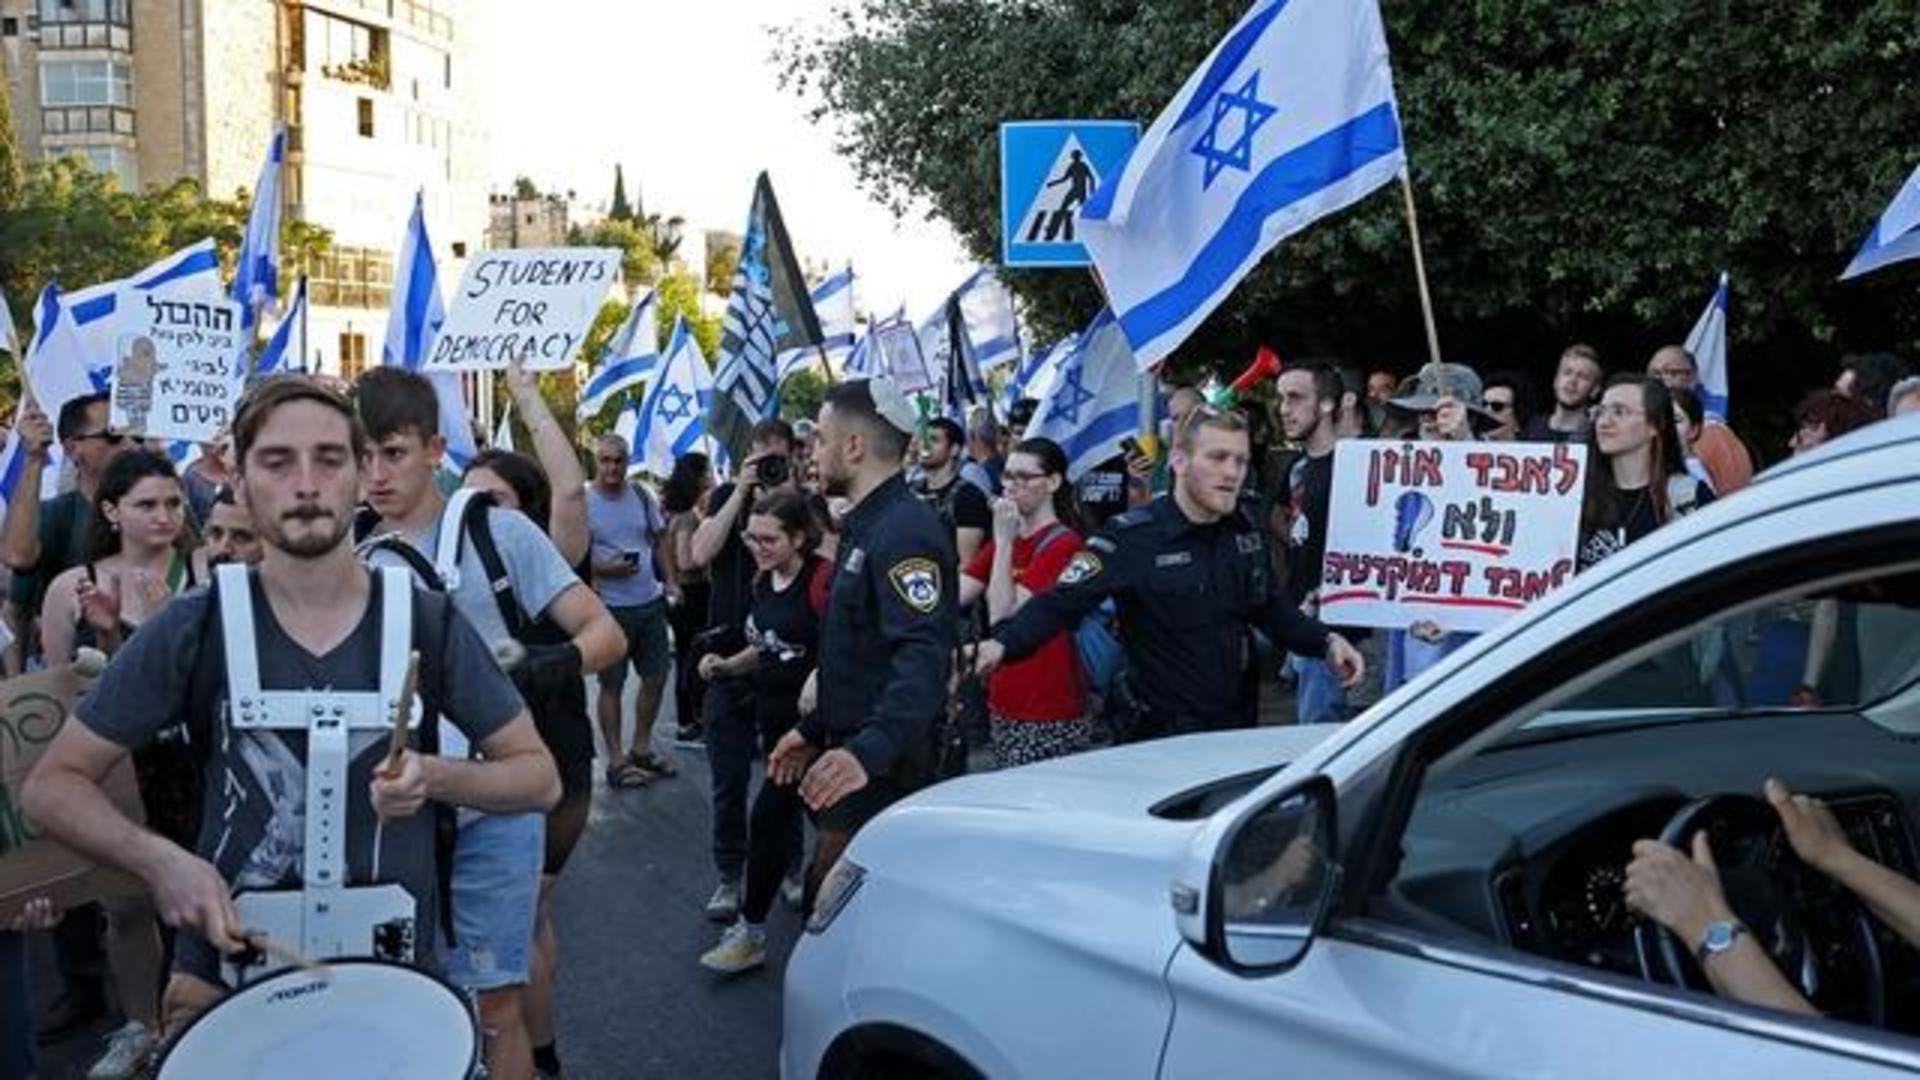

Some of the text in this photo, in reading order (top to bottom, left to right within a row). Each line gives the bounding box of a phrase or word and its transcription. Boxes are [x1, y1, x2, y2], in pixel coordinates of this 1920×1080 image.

[467, 259, 608, 298] STUDENTS
[145, 294, 233, 331] ההבדל
[493, 299, 548, 327] FOR
[432, 332, 580, 364] DEMOCRACY
[1466, 443, 1581, 496] לאבד
[1441, 496, 1517, 546] ולא
